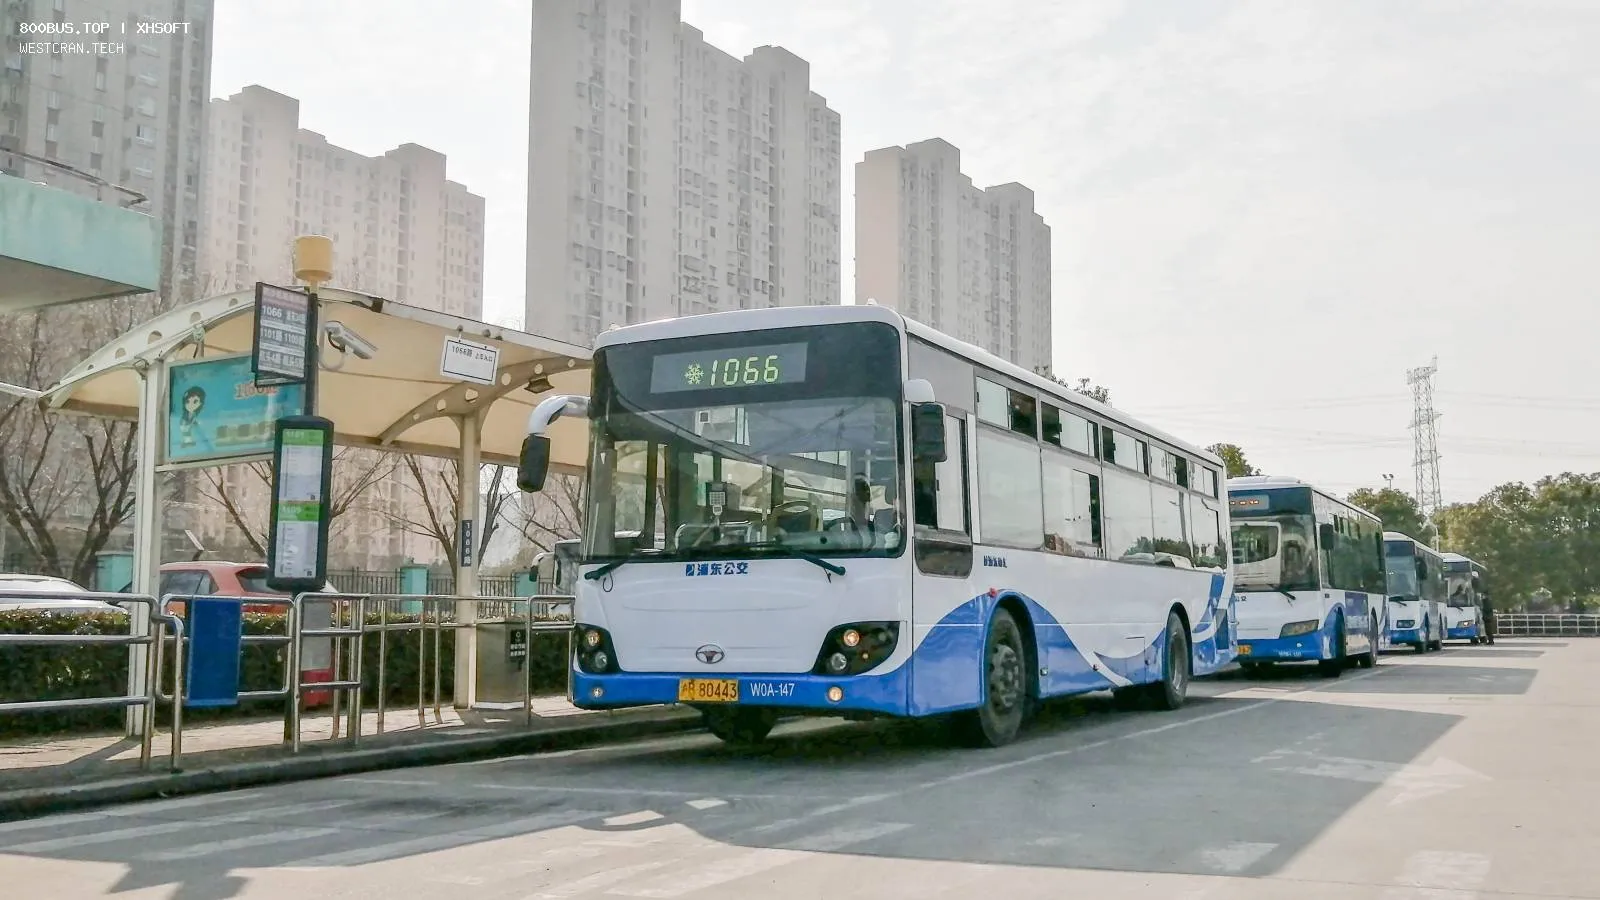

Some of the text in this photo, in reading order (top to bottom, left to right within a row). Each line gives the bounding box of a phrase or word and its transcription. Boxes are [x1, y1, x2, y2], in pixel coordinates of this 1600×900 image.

[710, 354, 779, 387] 1066
[697, 561, 749, 577] 浦东公交
[699, 682, 736, 698] 80443
